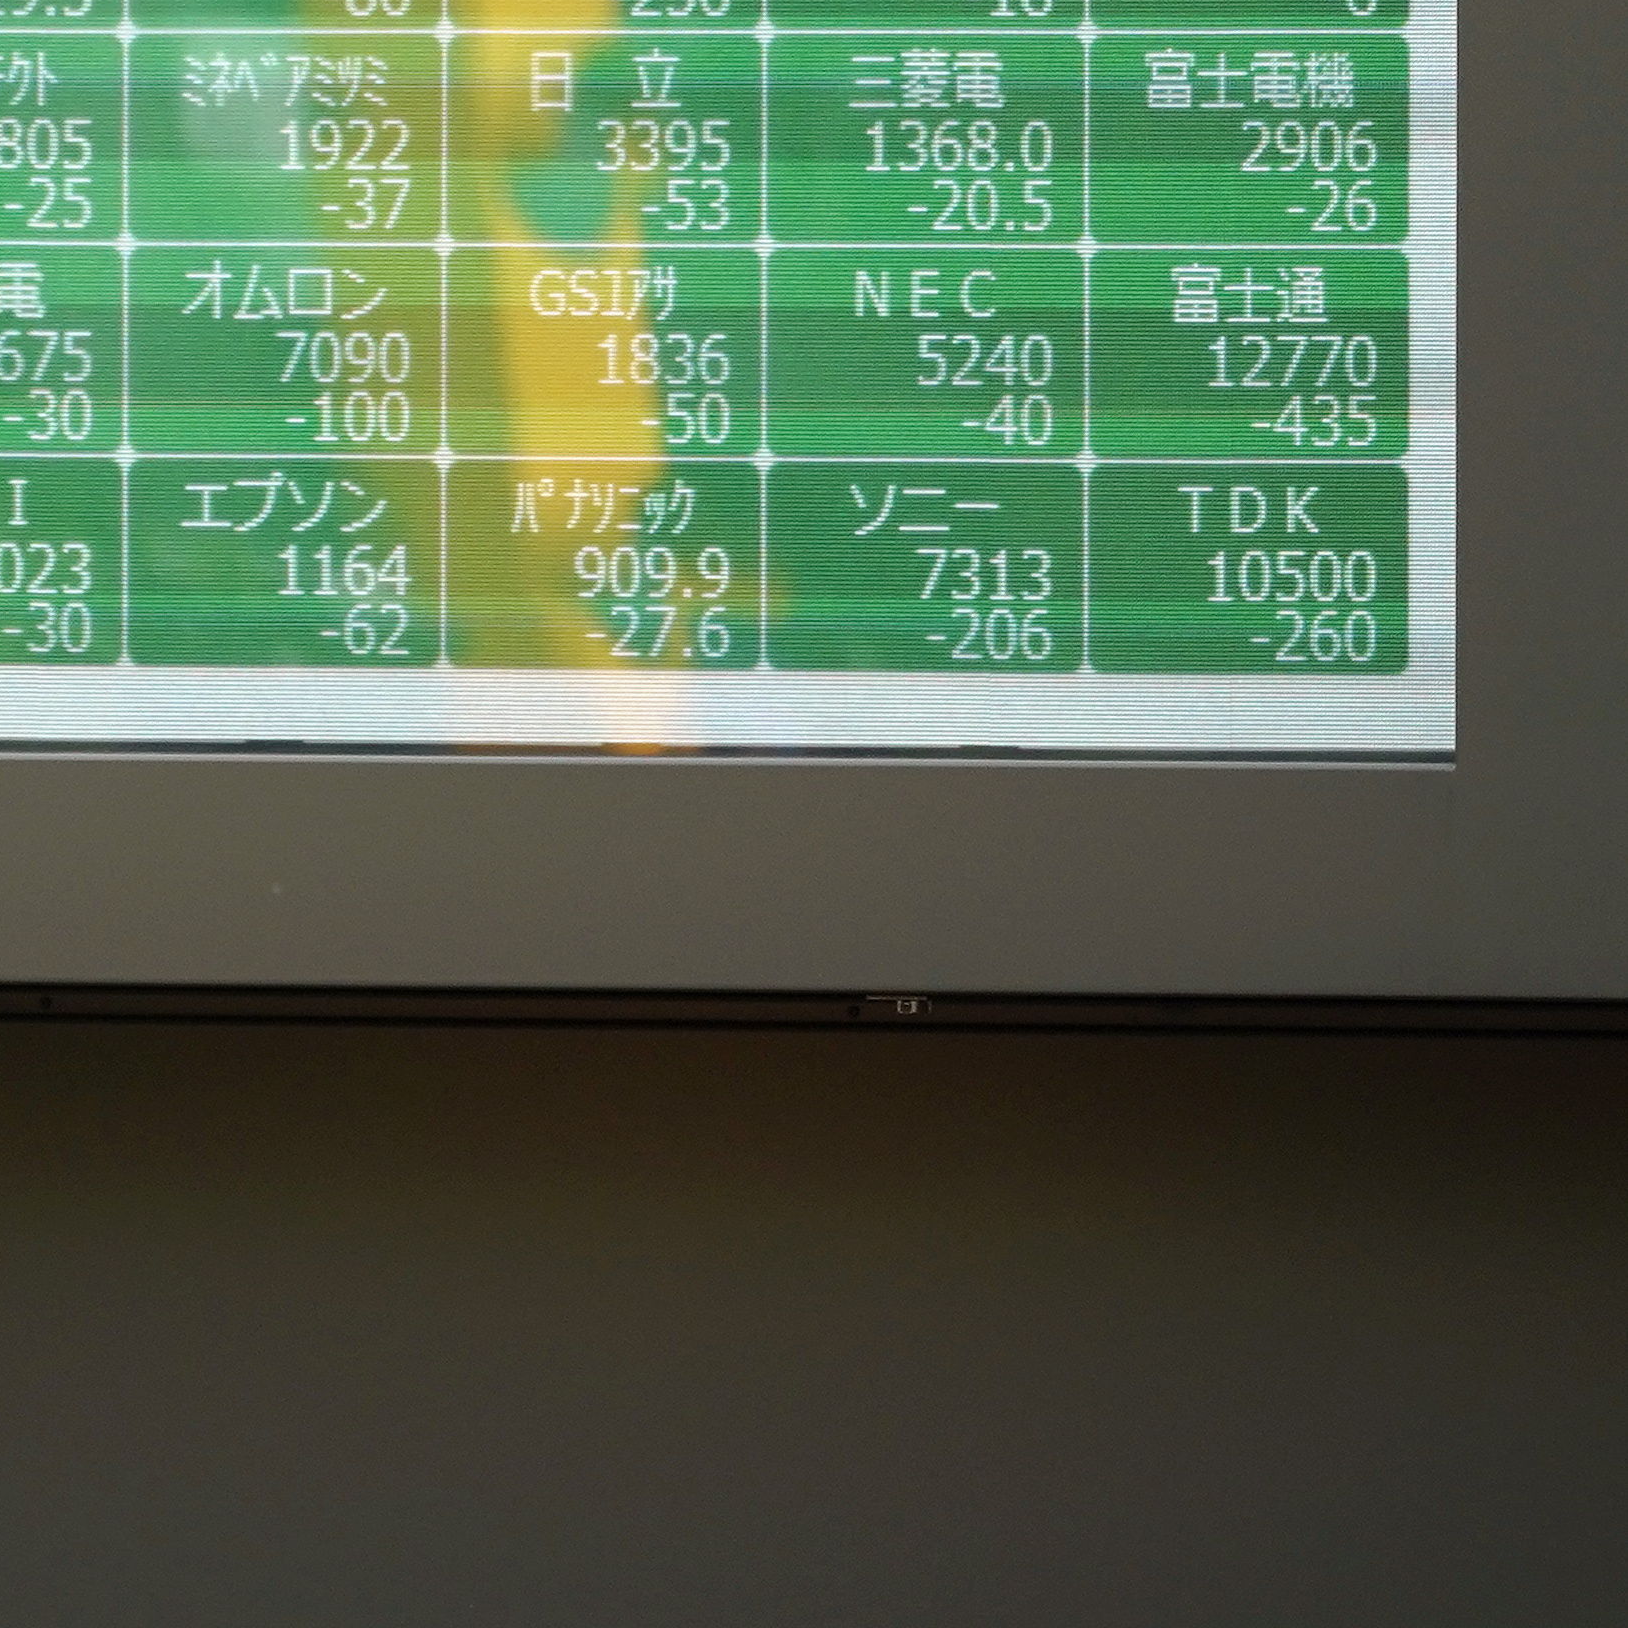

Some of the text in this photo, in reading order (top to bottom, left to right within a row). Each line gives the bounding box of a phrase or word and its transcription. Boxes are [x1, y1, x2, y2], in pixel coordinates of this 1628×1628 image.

[849, 48, 1004, 108] 三菱電
[1145, 47, 1354, 108] 富士電機
[865, 119, 1053, 173] 1368.0
[1240, 120, 1377, 173] 2906
[907, 178, 1052, 232] -20.5
[1286, 178, 1377, 232] -26
[183, 260, 387, 320] オムロン
[1171, 263, 1327, 323] 富士通
[276, 330, 411, 384] 7090
[1209, 334, 1377, 388] 12770
[3, 387, 93, 442] -30
[286, 390, 412, 443] -100
[1251, 394, 1376, 447] -435
[850, 484, 999, 536] ソニー
[916, 547, 1051, 601] 7313
[926, 606, 1052, 660] -206
